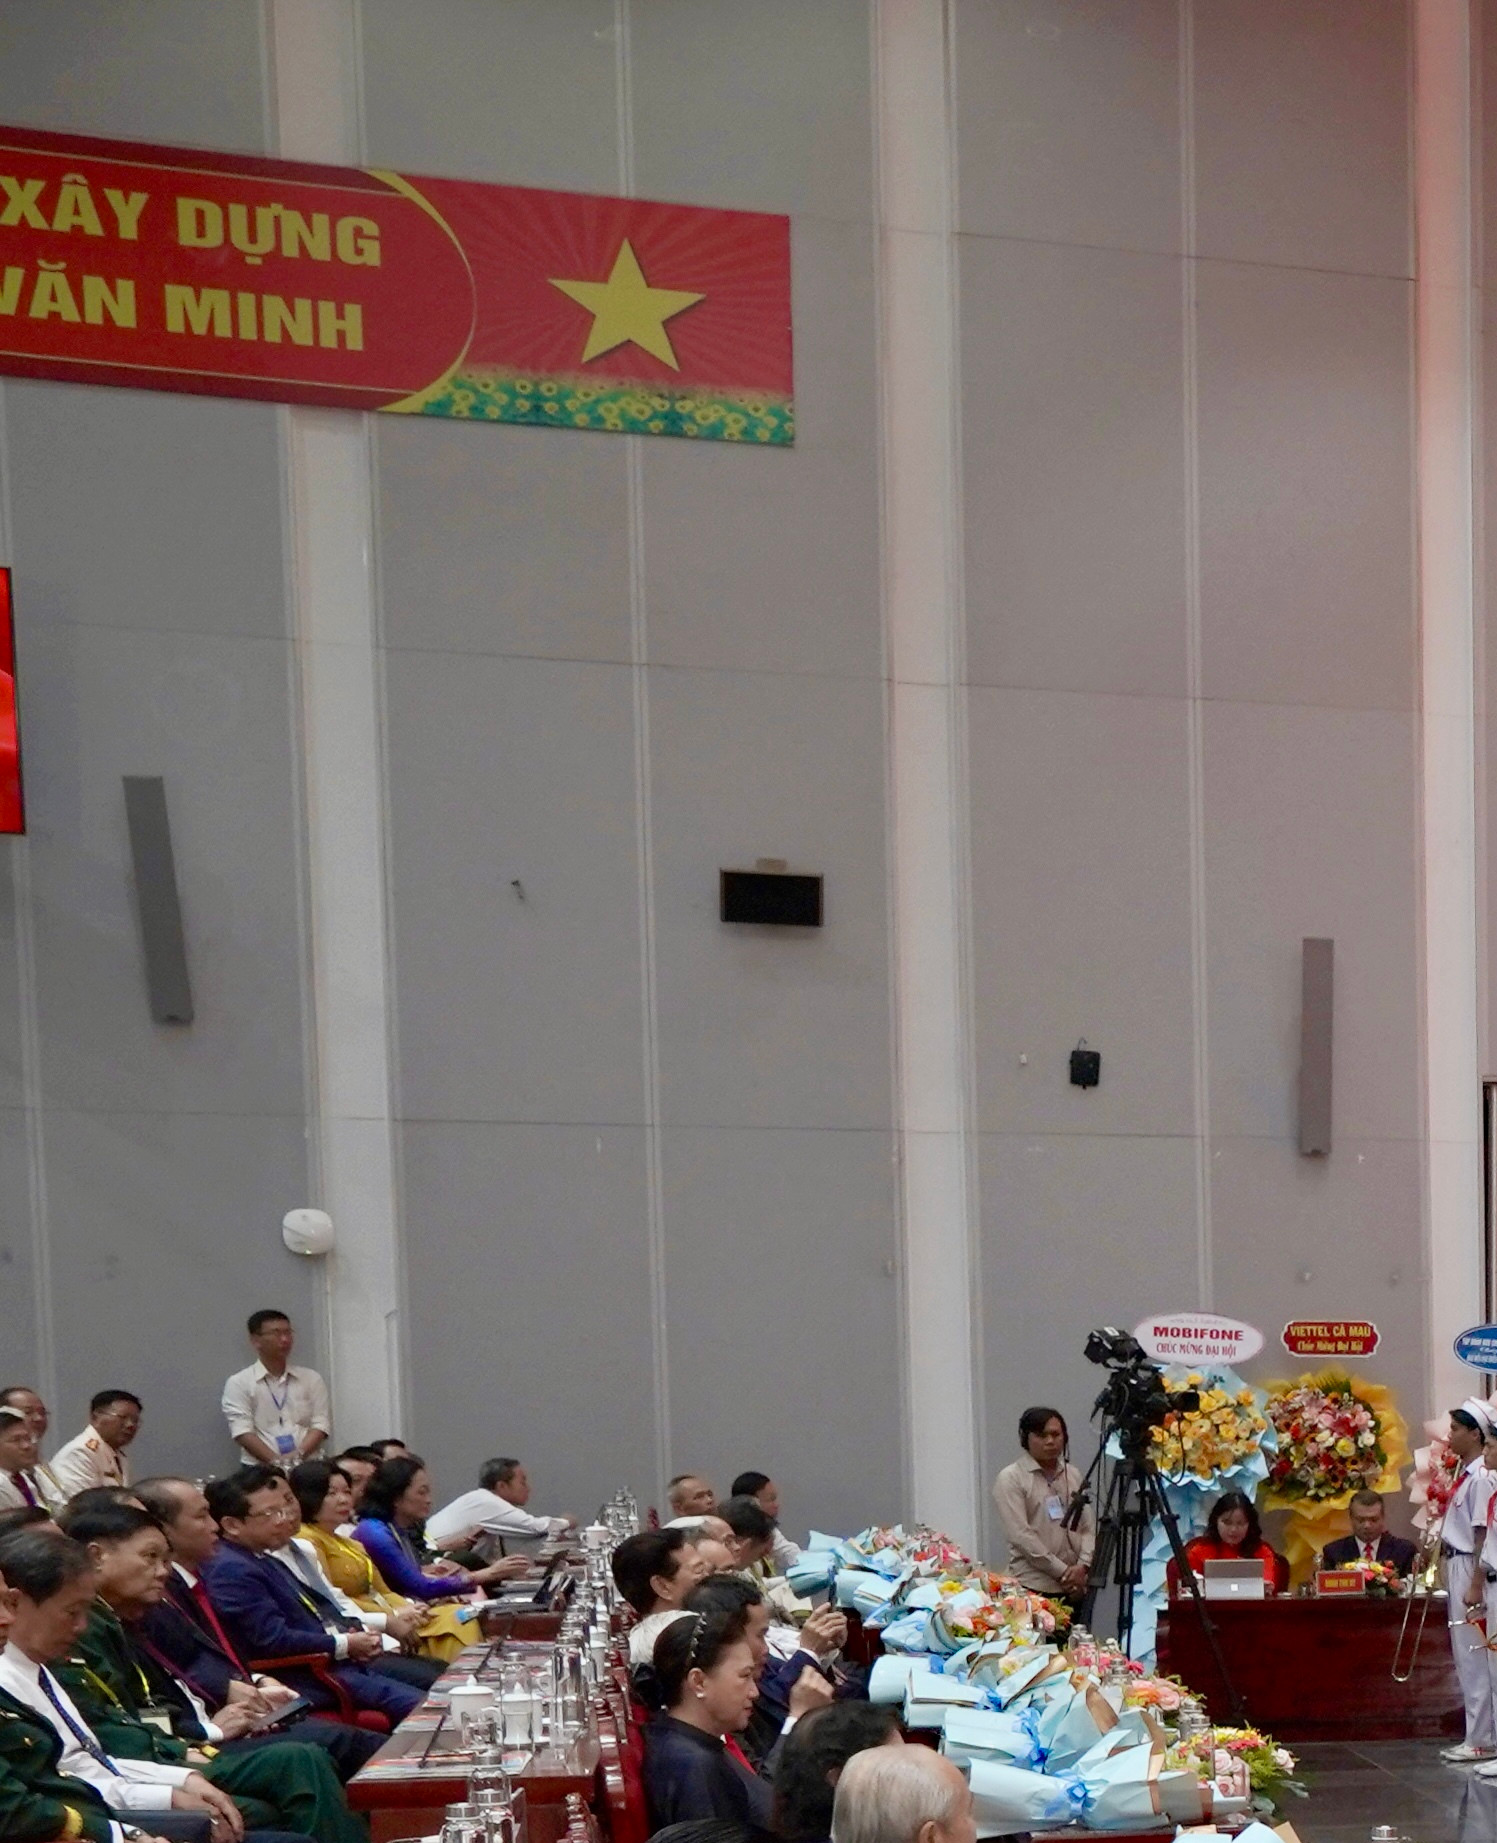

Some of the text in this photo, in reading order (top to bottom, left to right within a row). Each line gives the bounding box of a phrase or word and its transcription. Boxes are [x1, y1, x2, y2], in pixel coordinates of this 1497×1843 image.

[0, 173, 382, 267] XÂY DỰNG
[164, 283, 364, 351] MINH
[1153, 1326, 1244, 1341] MOBIFONE
[1290, 1323, 1371, 1337] VIETTEL CÀ MAU
